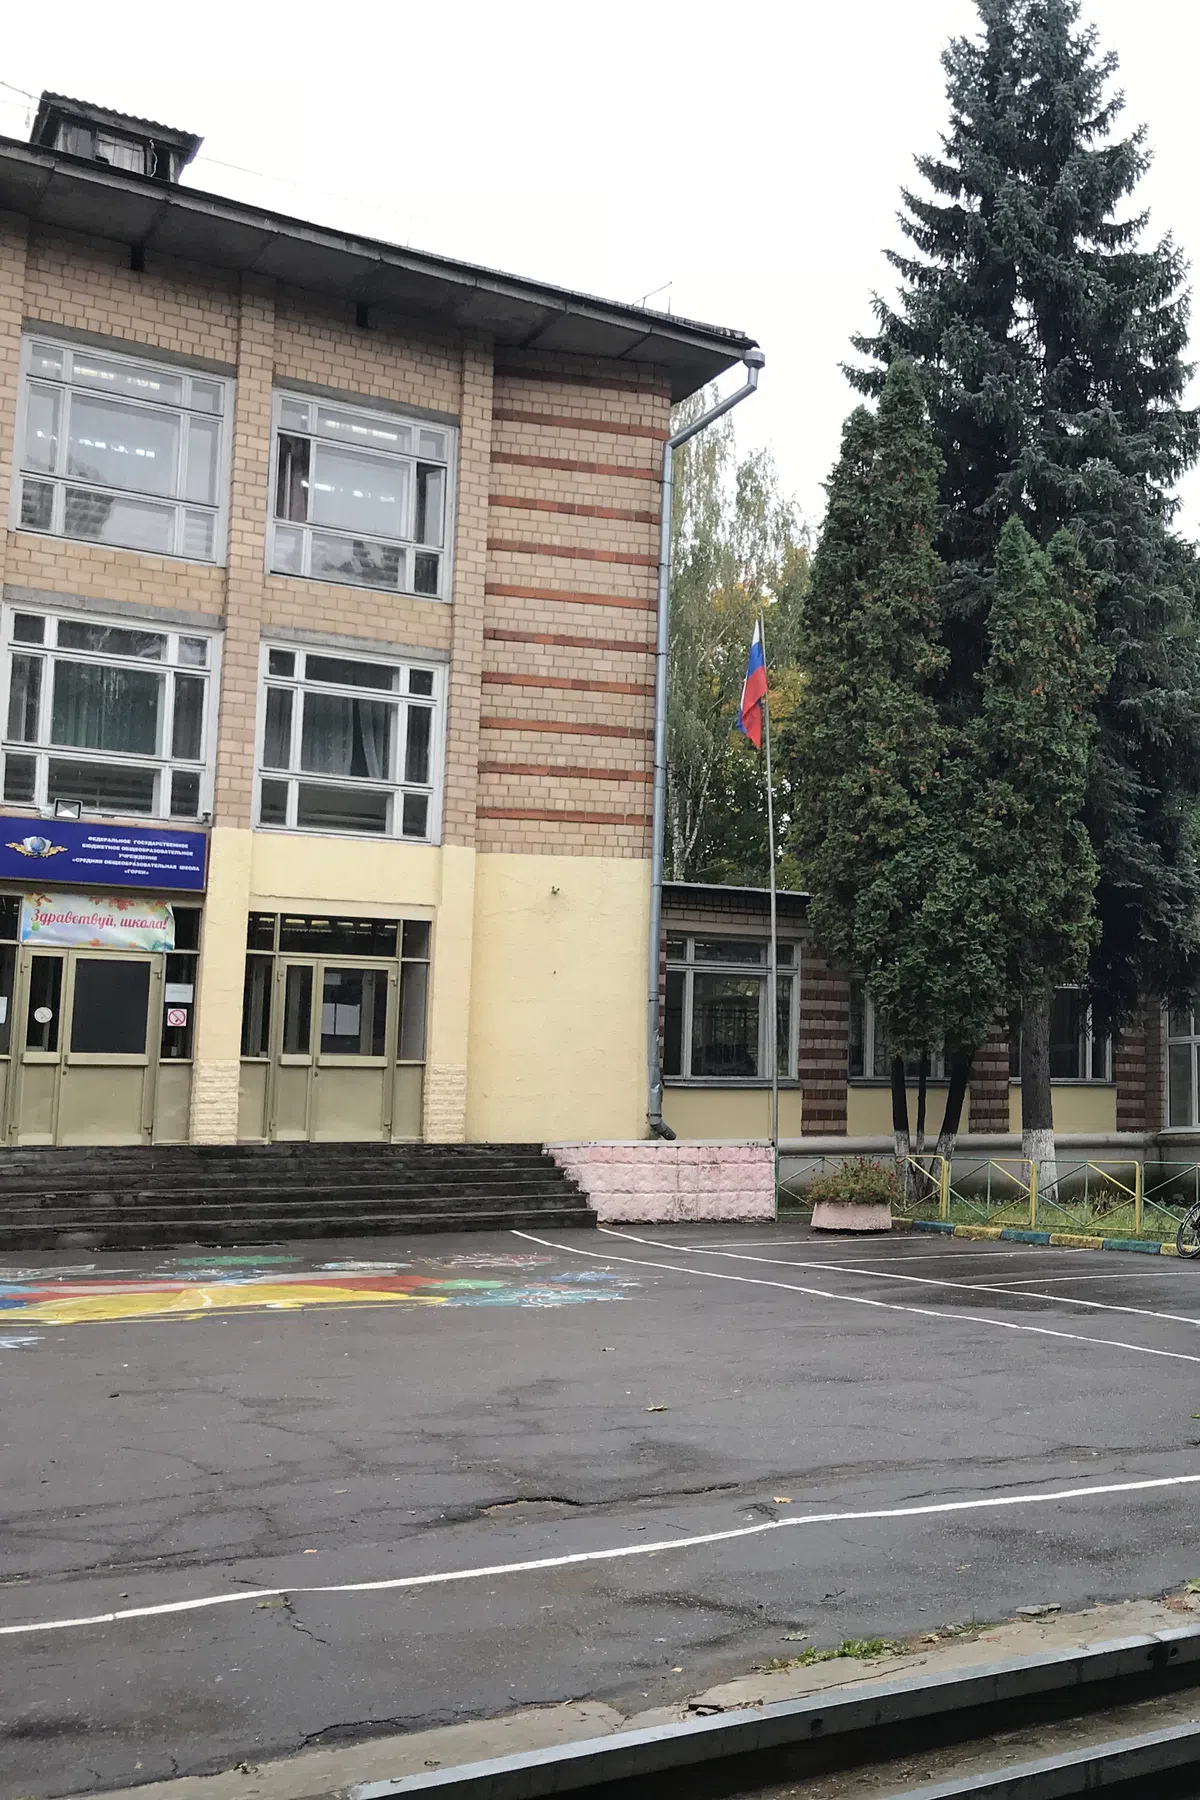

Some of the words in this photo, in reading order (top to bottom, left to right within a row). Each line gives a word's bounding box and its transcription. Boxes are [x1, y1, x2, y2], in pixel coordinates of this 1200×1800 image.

[88, 836, 131, 844] ФЕДЕРАЛЬНОЕ
[133, 839, 188, 848] ГОСУДАРСТВЕННОЕ
[121, 847, 193, 856] ОБЩЕОБРАЗОВАТЕЛЬНОЕ
[119, 853, 157, 861] УЧРЕЖДЕНИЕ
[31, 908, 117, 929] Здравствуй,
[119, 914, 169, 930] школа!
